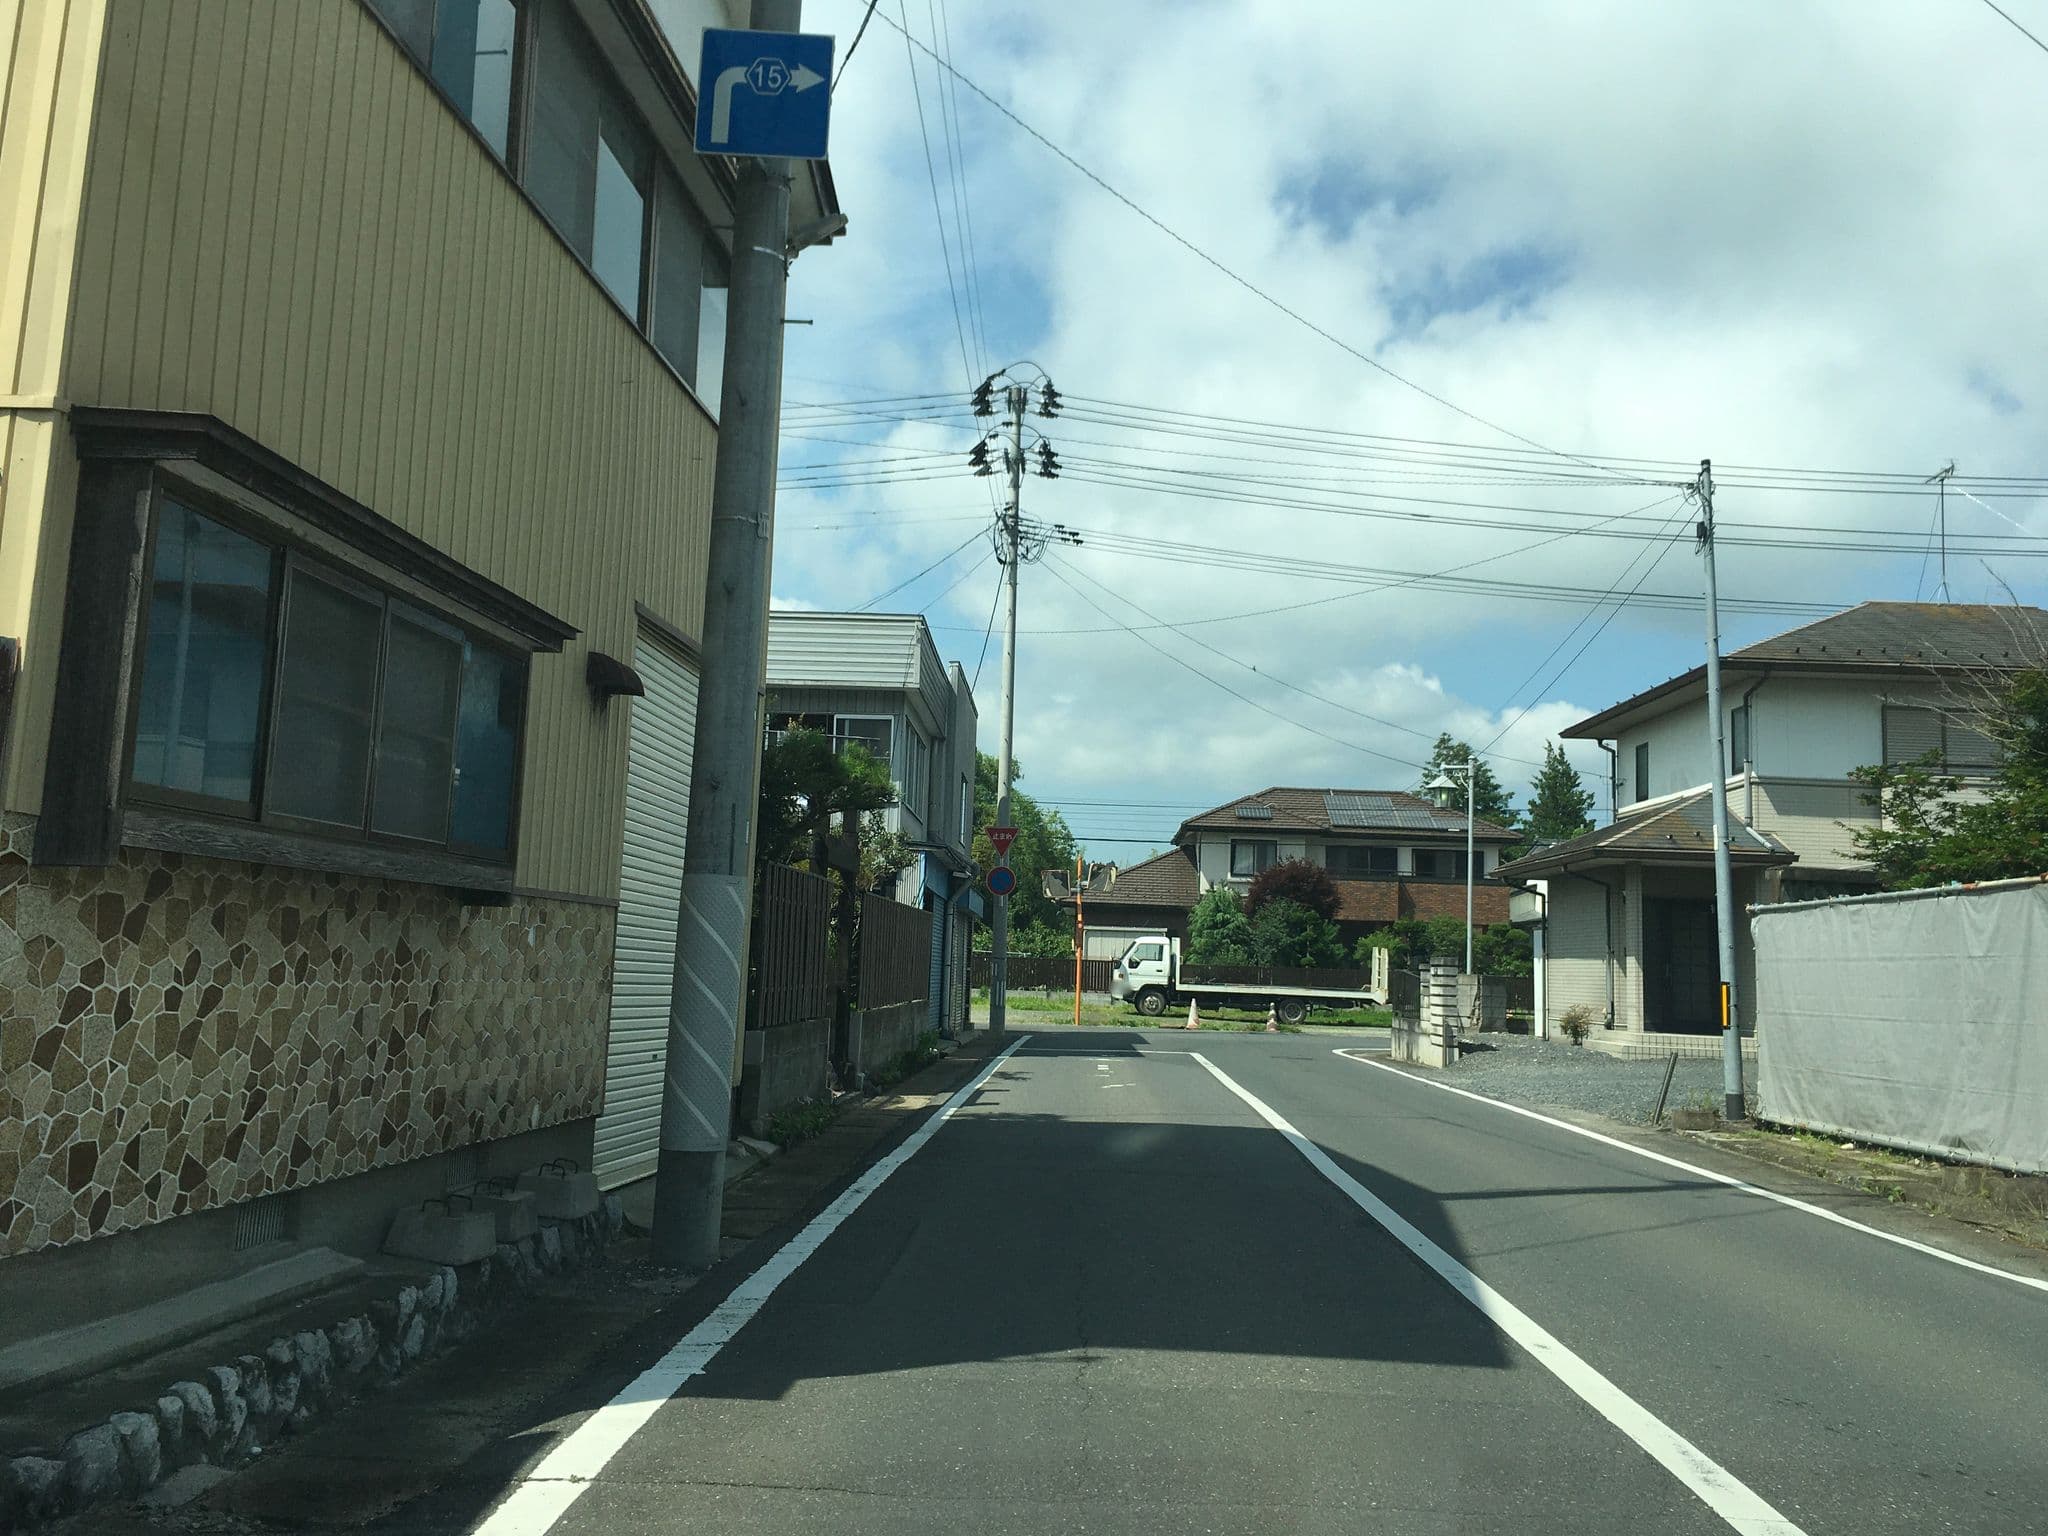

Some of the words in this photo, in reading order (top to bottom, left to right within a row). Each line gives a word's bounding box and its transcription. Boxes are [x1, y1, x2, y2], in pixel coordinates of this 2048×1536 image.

[755, 64, 782, 88] 15
[992, 832, 1013, 840] 止まれ
